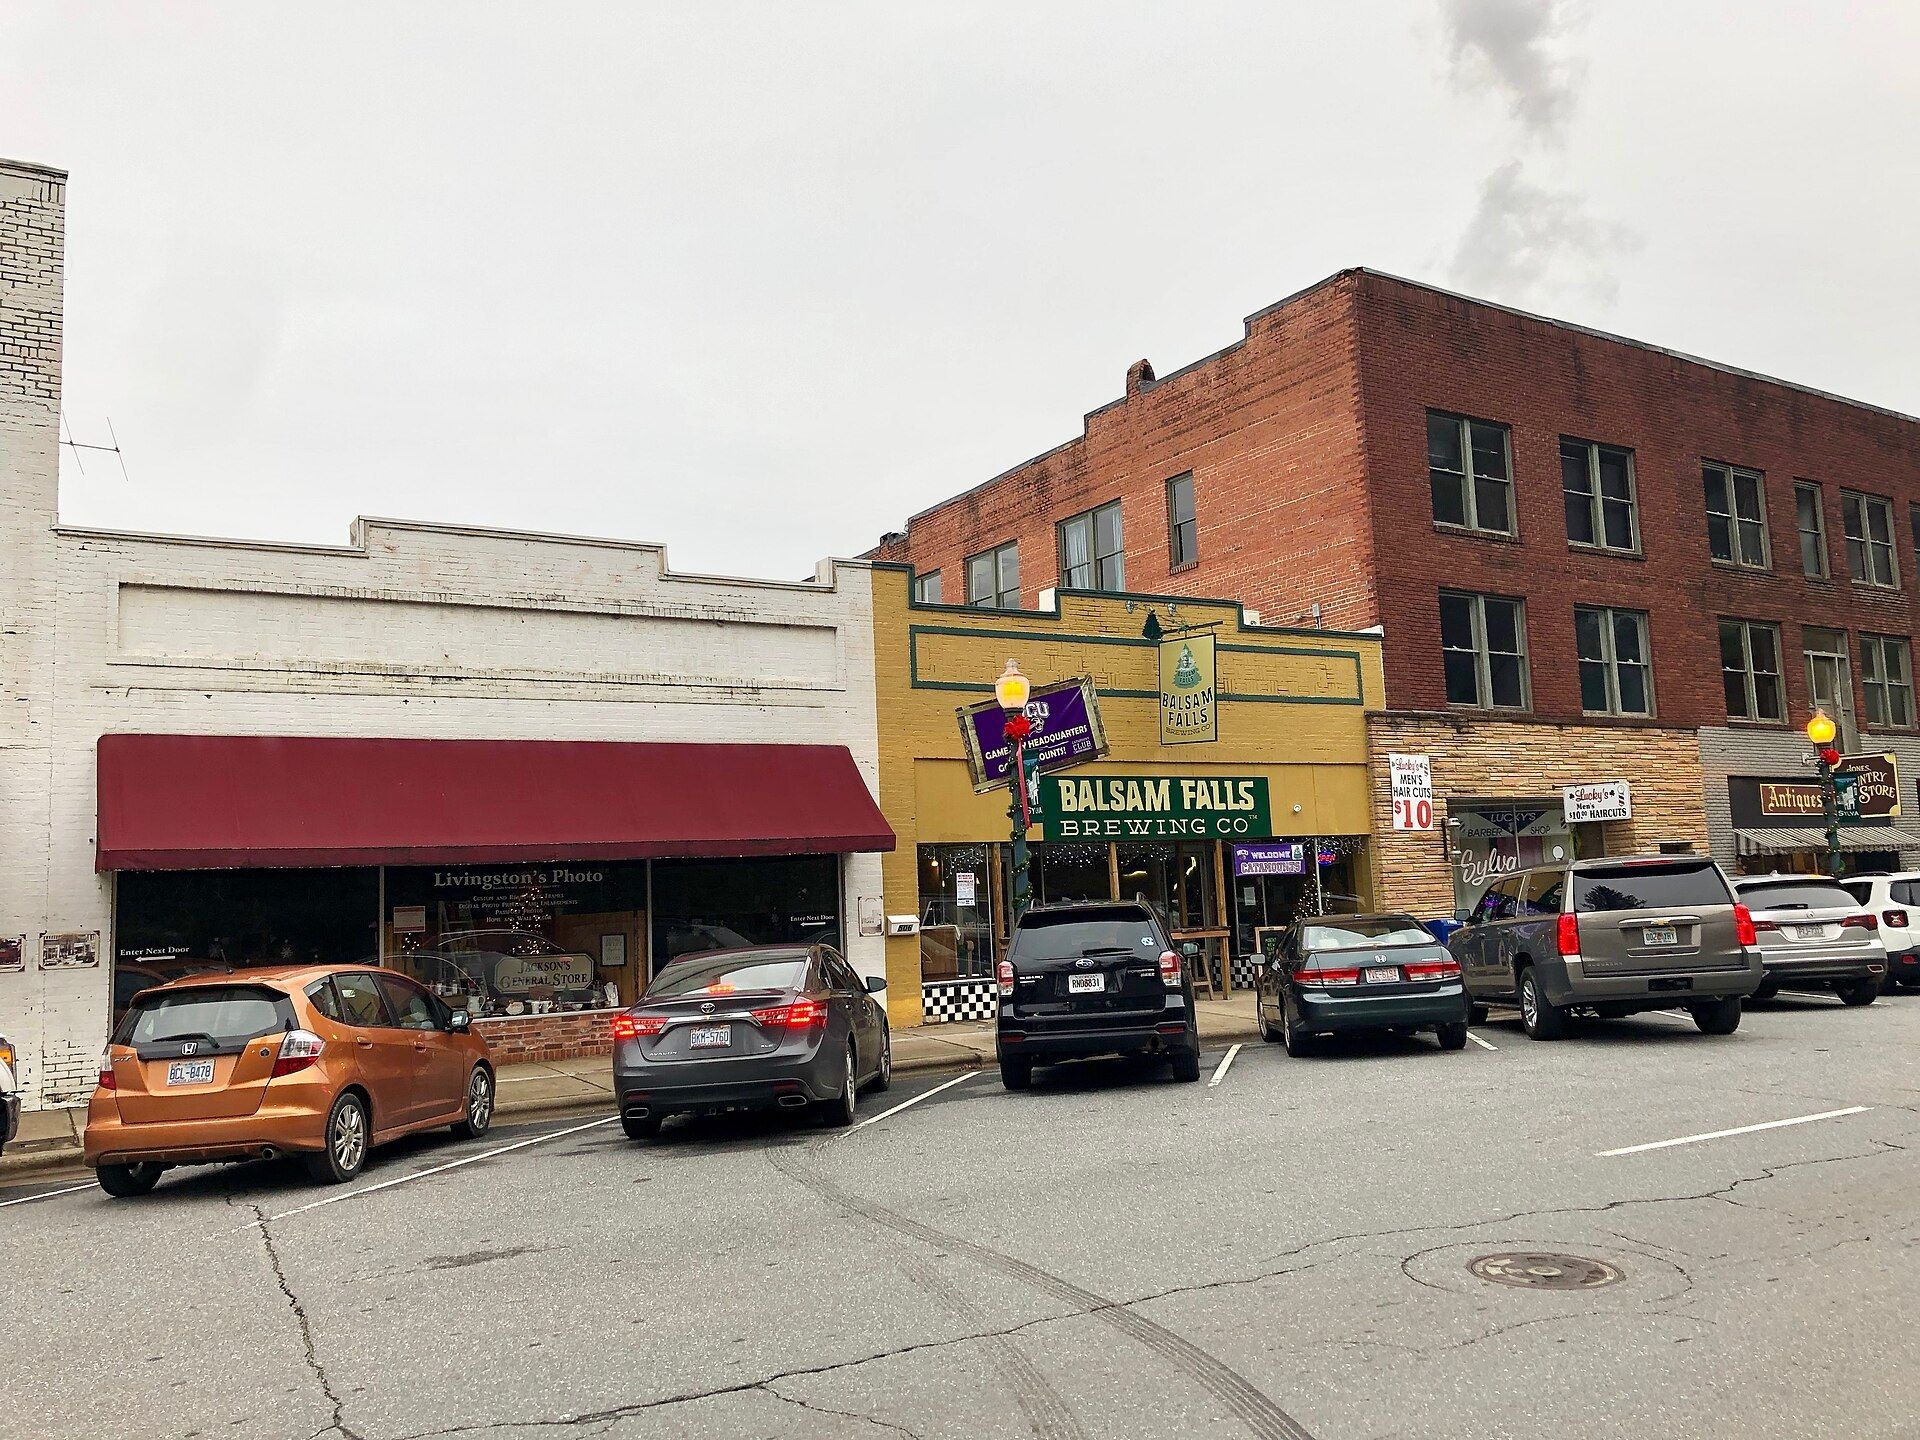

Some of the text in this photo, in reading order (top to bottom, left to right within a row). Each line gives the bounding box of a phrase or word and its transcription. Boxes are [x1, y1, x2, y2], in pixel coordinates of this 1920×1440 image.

[1162, 686, 1213, 711] BALSAM
[1022, 701, 1050, 719] CU
[1168, 708, 1208, 728] FALLS
[1027, 724, 1088, 749] HEADQUARTERS
[1165, 726, 1201, 736] BREWING
[1073, 740, 1092, 751] CLUB
[1396, 758, 1420, 774] Lucky's
[1400, 774, 1423, 785] MEN'S
[1057, 779, 1255, 812] BALSAM FALLS
[1393, 786, 1431, 798] HAIR CUTS
[1575, 788, 1609, 803] Lucky's
[1768, 785, 1823, 813] Antiques
[1859, 784, 1896, 804] STORE
[1576, 802, 1595, 810] Men's
[1590, 807, 1627, 818] HAIRCUTS
[1394, 800, 1432, 828] $10
[1490, 812, 1536, 822] LUCKY'S
[1060, 818, 1206, 836] BREWING
[1216, 818, 1248, 834] CO
[1467, 825, 1551, 837] BARBER SHOP
[1251, 851, 1291, 859] WELCOME
[1240, 861, 1302, 874] CATAMOUNTS
[1460, 847, 1517, 886] Sylva
[434, 870, 547, 890] Livingston's
[552, 869, 603, 883] Photo
[120, 946, 190, 956] Enter Next Door
[517, 961, 571, 974] JACKSON'S
[500, 973, 588, 988] GENERAL STORE
